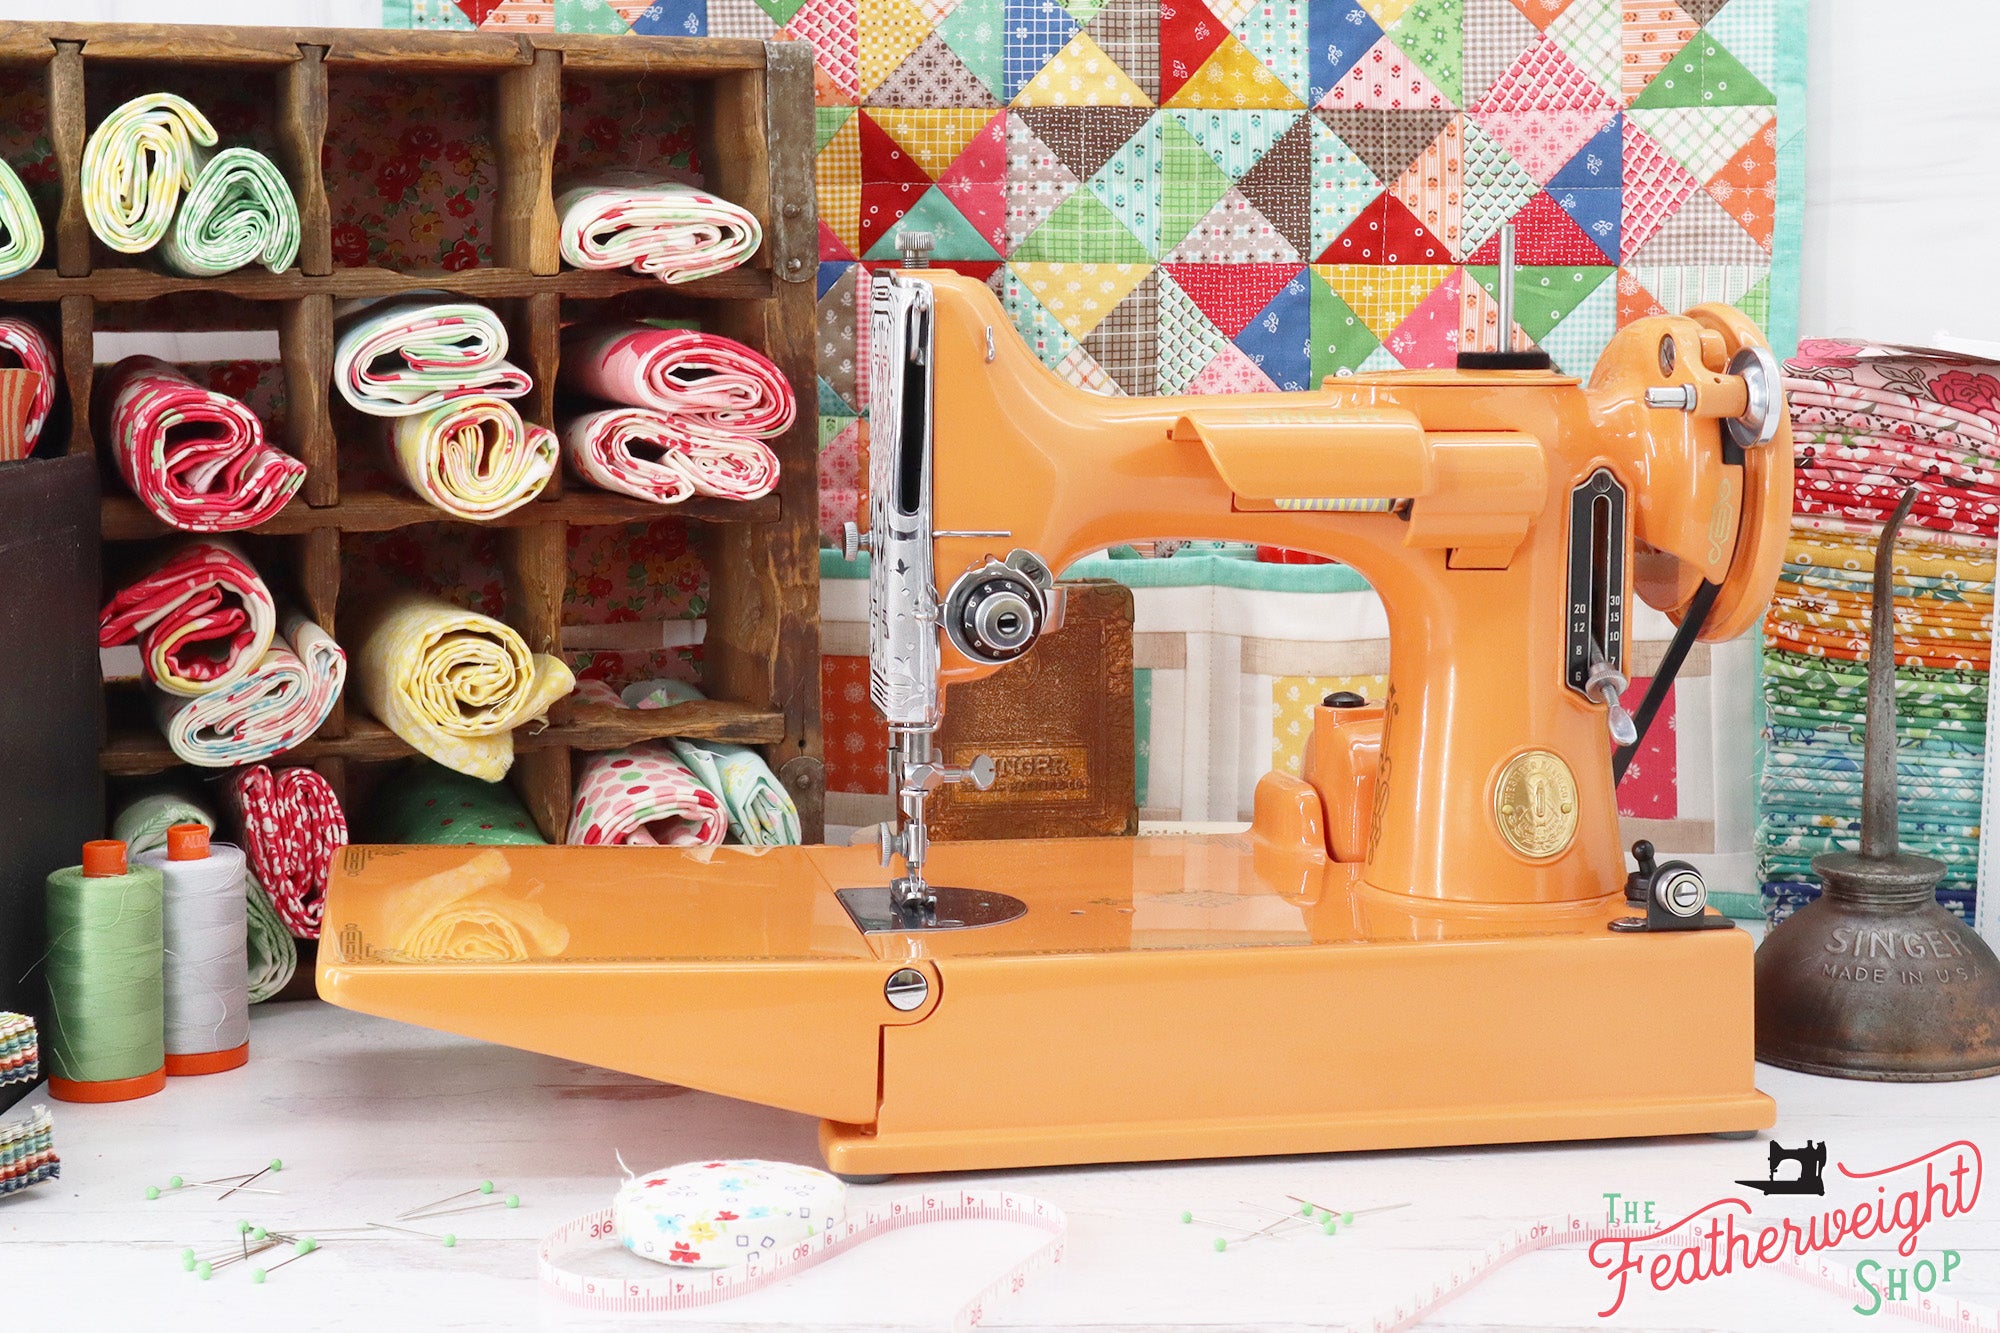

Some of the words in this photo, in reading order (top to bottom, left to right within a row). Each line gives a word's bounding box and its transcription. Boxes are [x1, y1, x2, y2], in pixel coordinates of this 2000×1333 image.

[968, 596, 976, 608] 6
[984, 585, 993, 594] 5
[1005, 582, 1013, 590] 4
[1023, 591, 1031, 599] 3
[1033, 610, 1040, 618] 2
[1610, 595, 1620, 606] 30
[1574, 604, 1586, 614] 20
[1610, 612, 1620, 622] 15
[1574, 622, 1585, 632] 12
[1609, 631, 1620, 641] 10
[1576, 645, 1582, 655] 8
[1611, 657, 1616, 665] 7
[1575, 671, 1582, 681] 6
[1825, 928, 1972, 960] SINGER
[1822, 963, 1885, 984] MADE
[1901, 971, 1924, 985] IN
[927, 1198, 935, 1208] 5
[966, 1196, 975, 1205] 4
[1005, 1198, 1013, 1207] 3
[590, 1220, 613, 1238] 36
[1654, 1221, 1662, 1231] 7
[1530, 1224, 1548, 1240] 40
[1793, 1255, 1800, 1265] 3
[750, 1266, 757, 1277] 2
[1821, 1266, 1828, 1277] 2
[716, 1275, 724, 1286] 3
[630, 1285, 639, 1296] 5
[676, 1283, 684, 1293] 4
